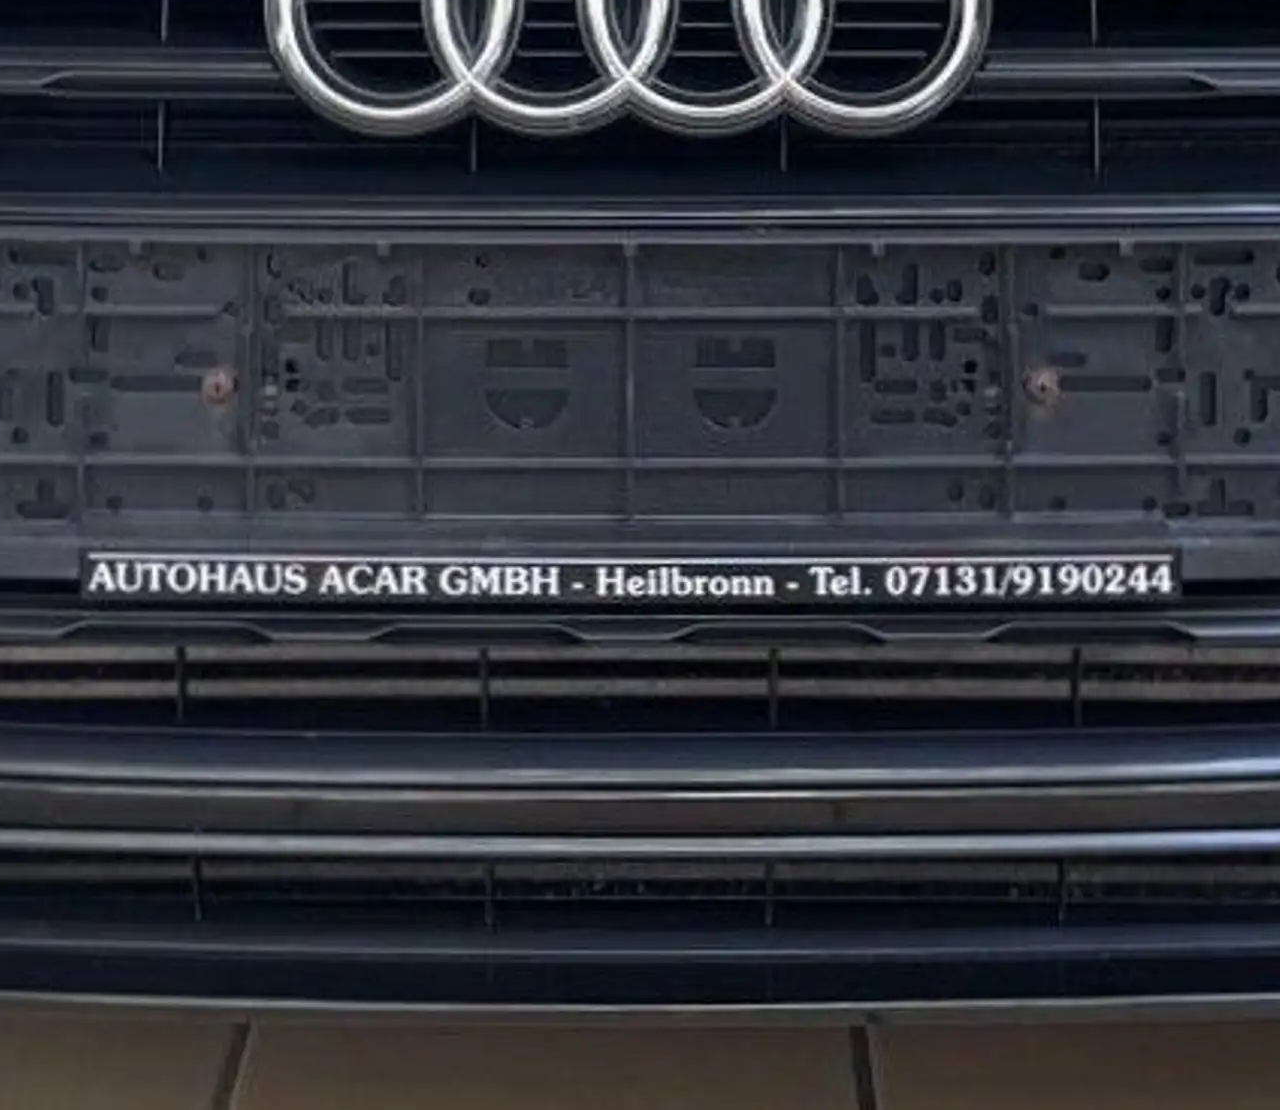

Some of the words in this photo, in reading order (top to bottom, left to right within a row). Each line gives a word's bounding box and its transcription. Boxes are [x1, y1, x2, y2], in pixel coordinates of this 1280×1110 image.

[89, 561, 308, 595] AUTOHAUS
[319, 563, 429, 596] ACAR
[439, 565, 561, 597] GMBH
[595, 566, 776, 597] Heilbronn
[808, 565, 872, 597] Tel.
[885, 563, 1173, 597] 07131/9190244
